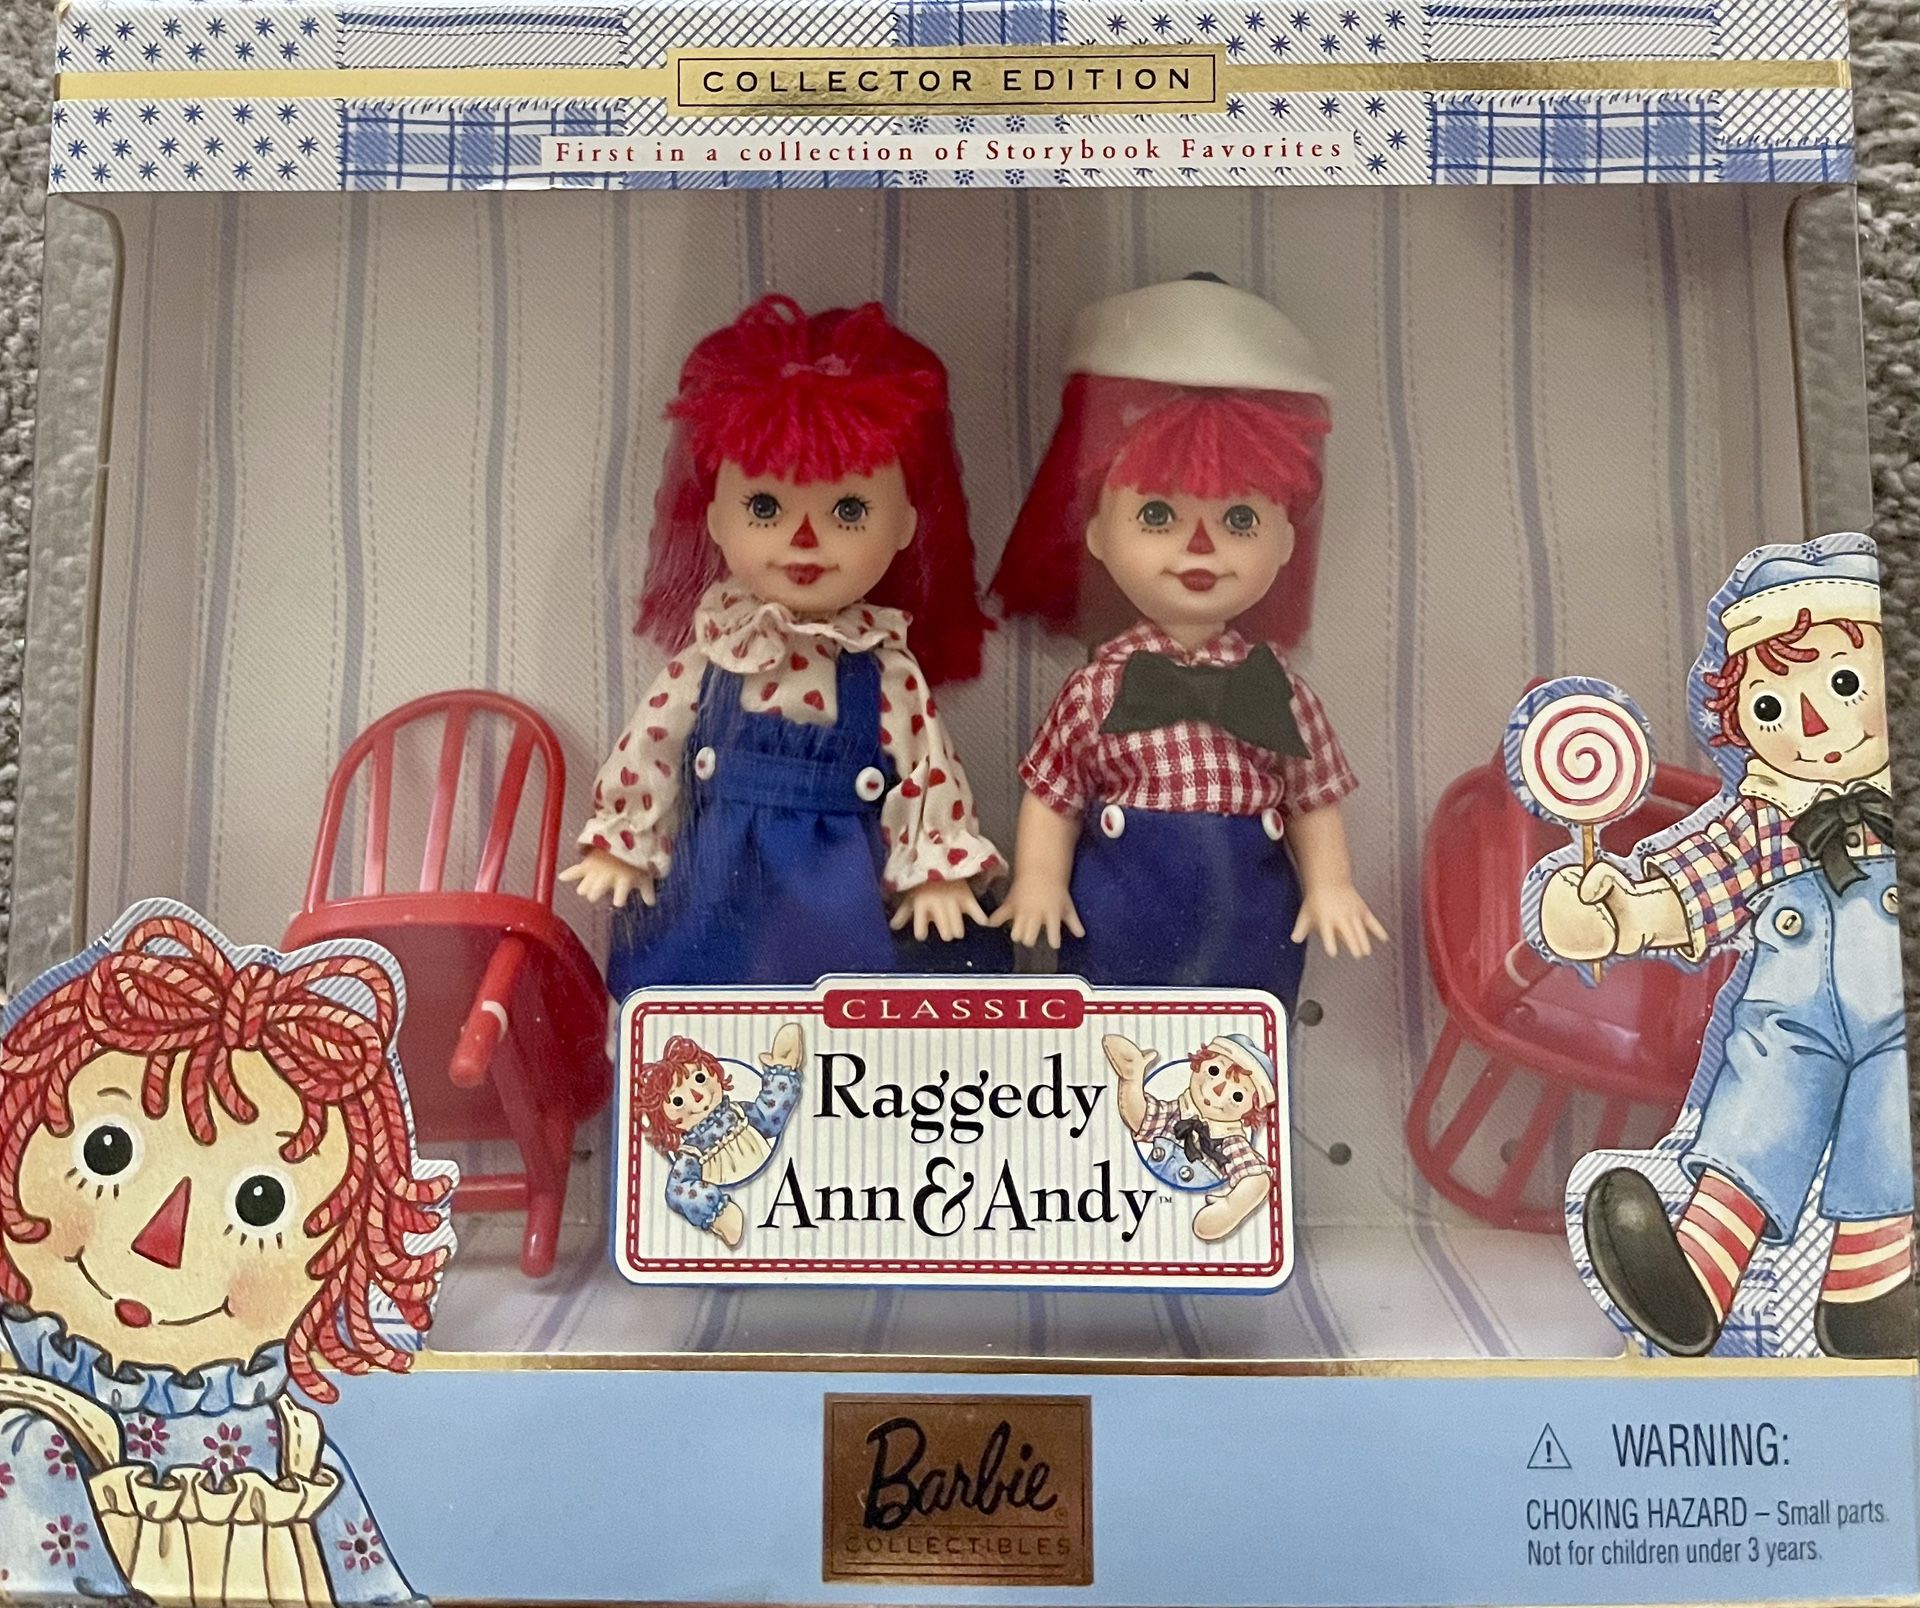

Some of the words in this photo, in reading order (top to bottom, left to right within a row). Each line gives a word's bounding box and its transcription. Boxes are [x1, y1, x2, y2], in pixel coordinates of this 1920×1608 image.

[703, 70, 973, 93] COLLECTOR
[1003, 67, 1191, 92] EDITION
[556, 142, 635, 162] First
[655, 141, 685, 161] in
[705, 145, 719, 161] a
[739, 140, 914, 162] collection
[934, 139, 969, 161] of
[985, 138, 1161, 165] Storybook
[1181, 138, 1342, 160] Favorites
[841, 998, 1068, 1020] CLASSIC
[814, 1053, 1107, 1144] Raggedy
[1612, 1422, 1790, 1468] WARNING:
[863, 1416, 1058, 1531] Barbie
[1526, 1497, 1639, 1531] CHOKING
[1647, 1497, 1748, 1529] HAZARD
[1777, 1499, 1831, 1527] Small
[846, 1536, 1071, 1556] COLLECTIBLES
[1527, 1540, 1562, 1566] Not
[1568, 1540, 1595, 1565] for
[1601, 1539, 1679, 1566] children
[1686, 1539, 1741, 1564] under
[1748, 1537, 1760, 1563] 3
[1765, 1537, 1823, 1568] years.
